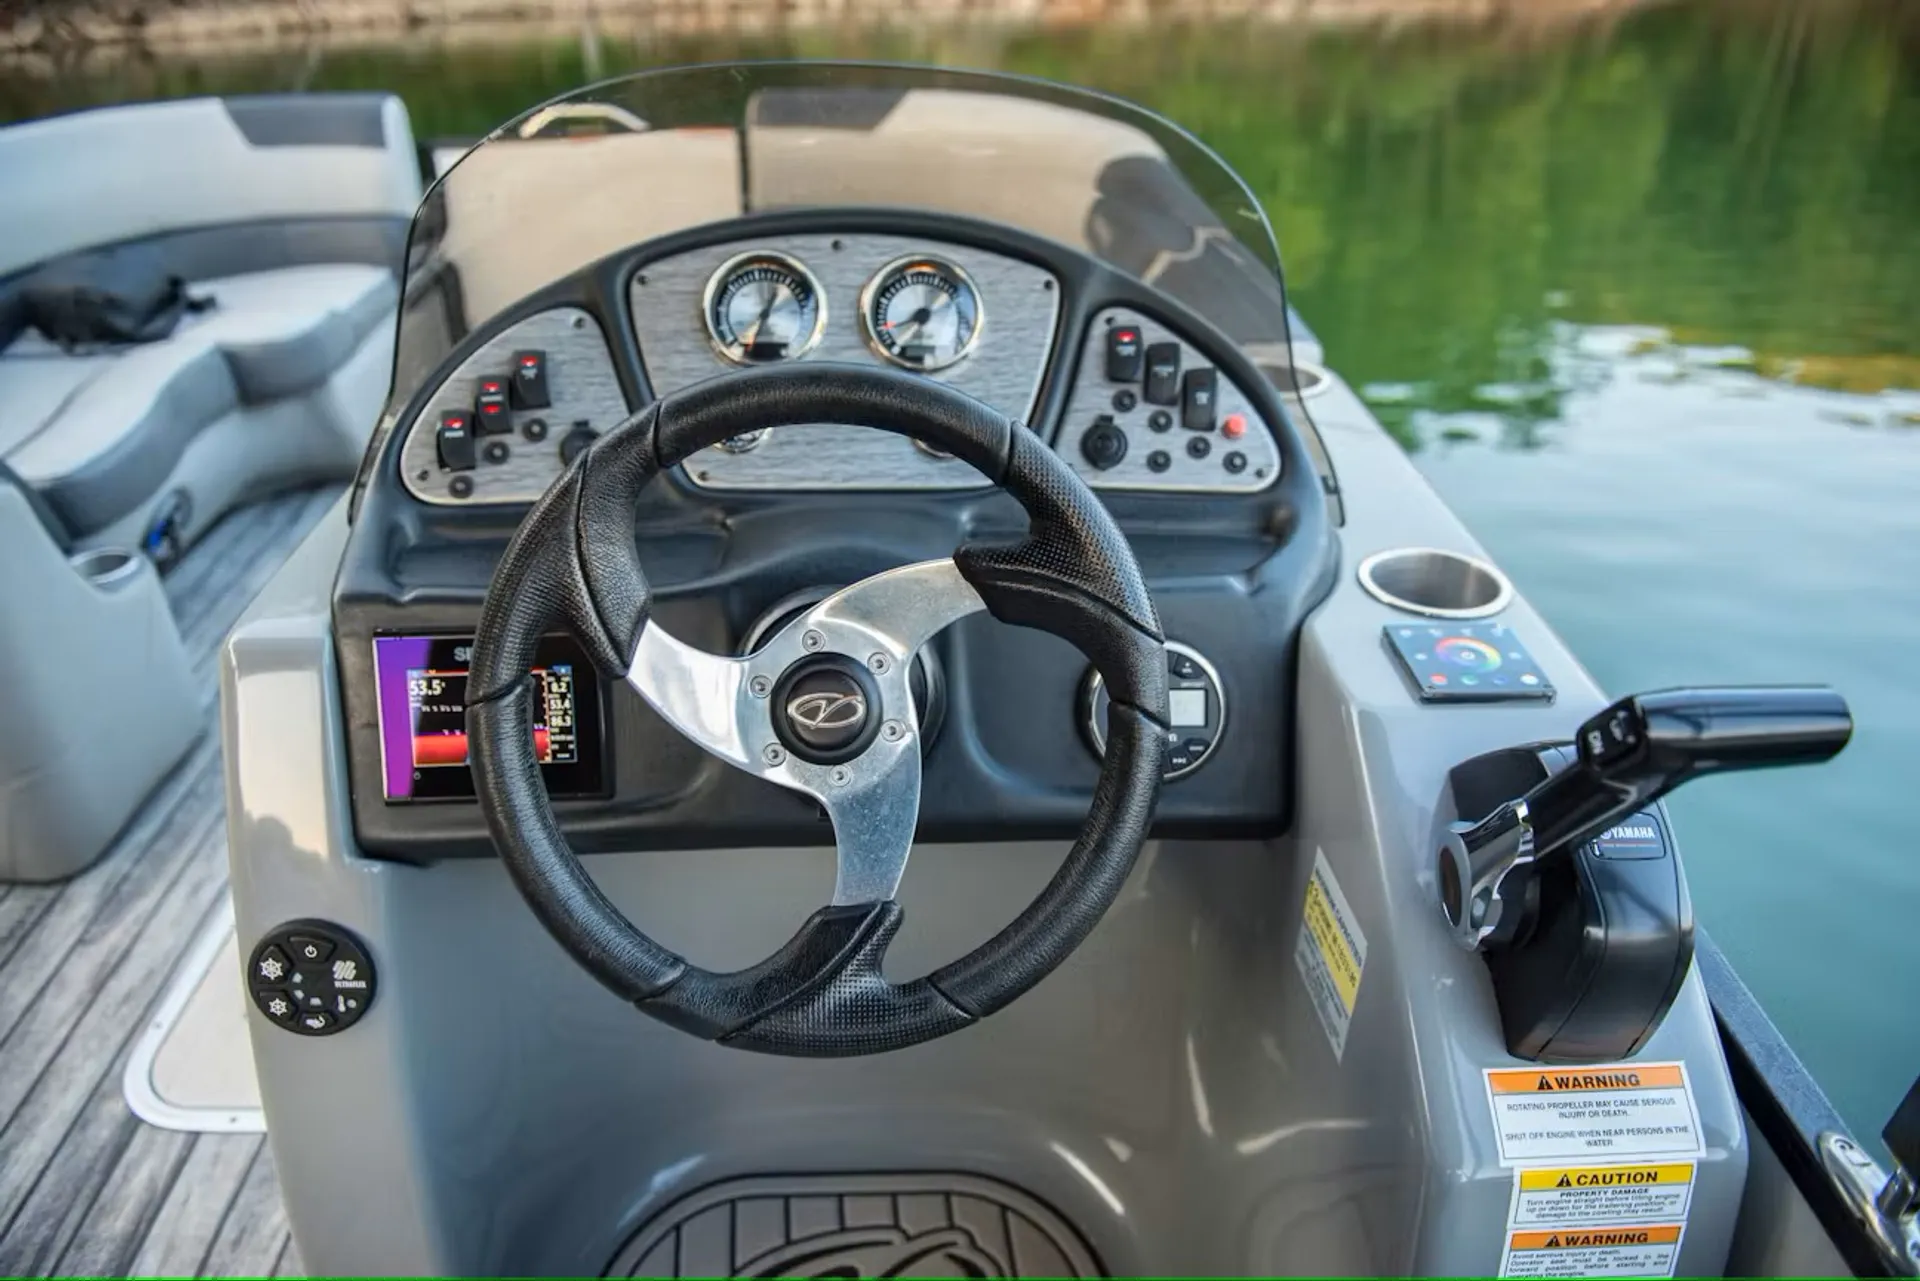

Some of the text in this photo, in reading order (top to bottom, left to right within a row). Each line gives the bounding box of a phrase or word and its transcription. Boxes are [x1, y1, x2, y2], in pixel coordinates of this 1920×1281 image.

[1611, 826, 1655, 839] YAMAHA
[1554, 1073, 1641, 1090] WARNING
[1506, 1097, 1676, 1112] ROTATING PROPELLER MAY CAUSE SERIOUS
[1558, 1110, 1586, 1119] INJURY
[1588, 1110, 1600, 1118] OR
[1505, 1125, 1689, 1141] SHUT OFF ENGINE WHEN NEAR PERSONS IN THE
[1576, 1171, 1658, 1186] CAUTION
[1545, 1198, 1572, 1207] engine
[1654, 1193, 1681, 1201] engine
[1560, 1187, 1649, 1198] PROPERTY DAMAGE
[1565, 1232, 1649, 1247] WARNING
